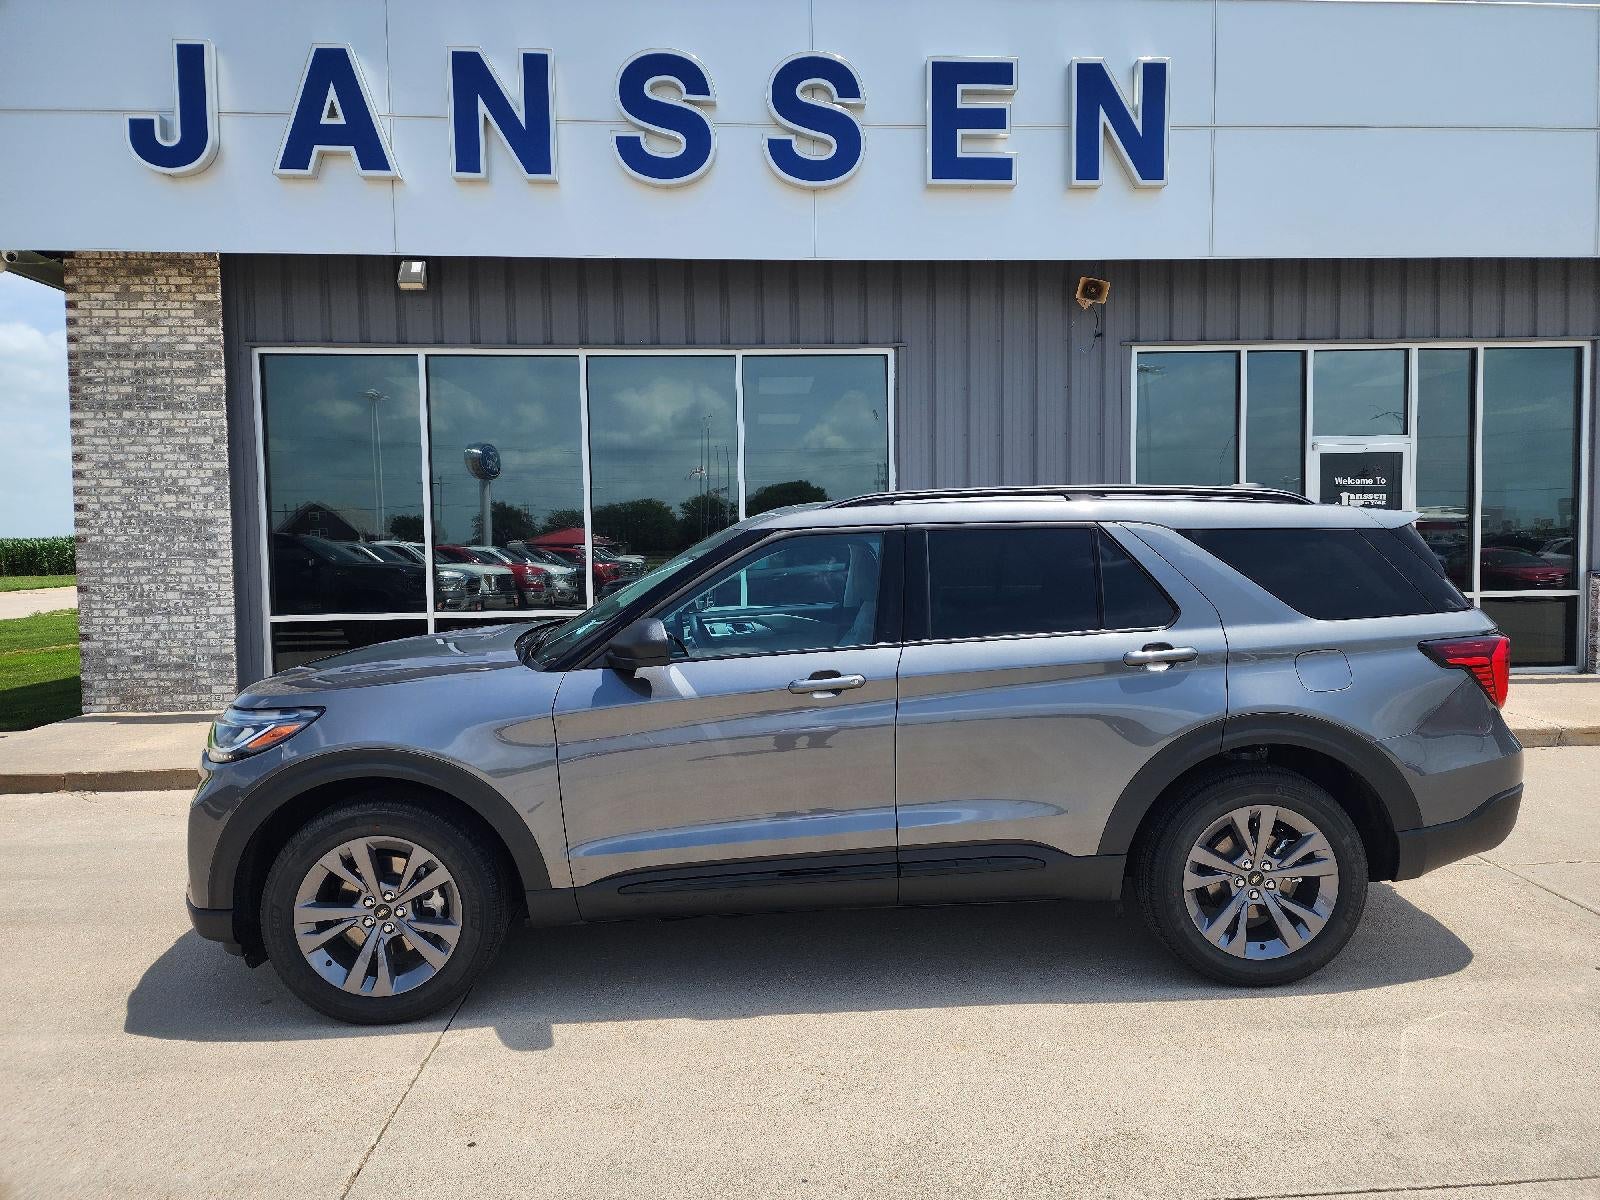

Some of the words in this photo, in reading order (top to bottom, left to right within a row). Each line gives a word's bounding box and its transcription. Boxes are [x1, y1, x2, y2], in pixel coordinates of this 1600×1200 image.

[125, 39, 1171, 190] JANSSEN
[1335, 476, 1373, 485] Welcome
[1376, 476, 1386, 485] To
